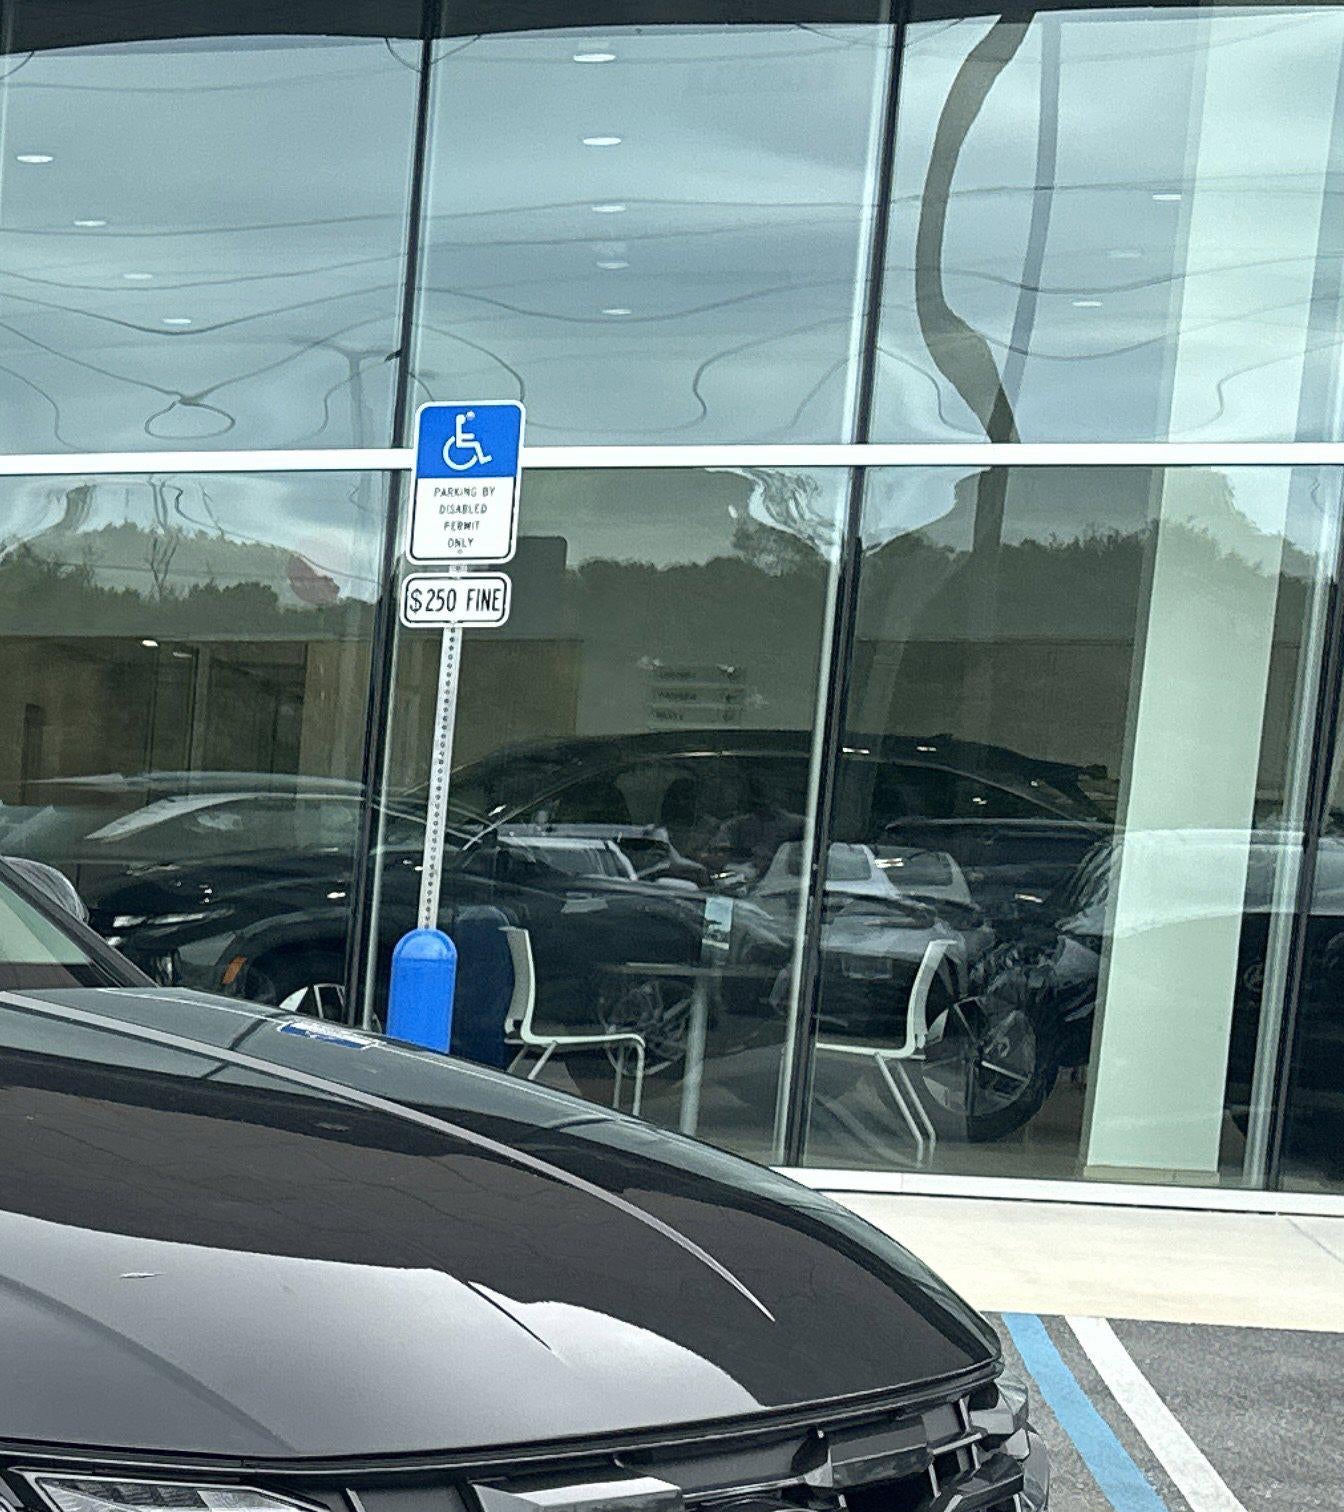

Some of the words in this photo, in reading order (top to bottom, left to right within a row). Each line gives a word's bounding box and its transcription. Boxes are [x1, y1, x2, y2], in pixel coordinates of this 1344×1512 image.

[433, 486, 478, 498] PARKING
[482, 486, 496, 497] BY
[439, 503, 488, 515] DISABLED
[443, 520, 481, 532] PERMIT
[447, 537, 475, 548] ONLY
[409, 588, 458, 613] $250
[466, 588, 502, 612] FINE
